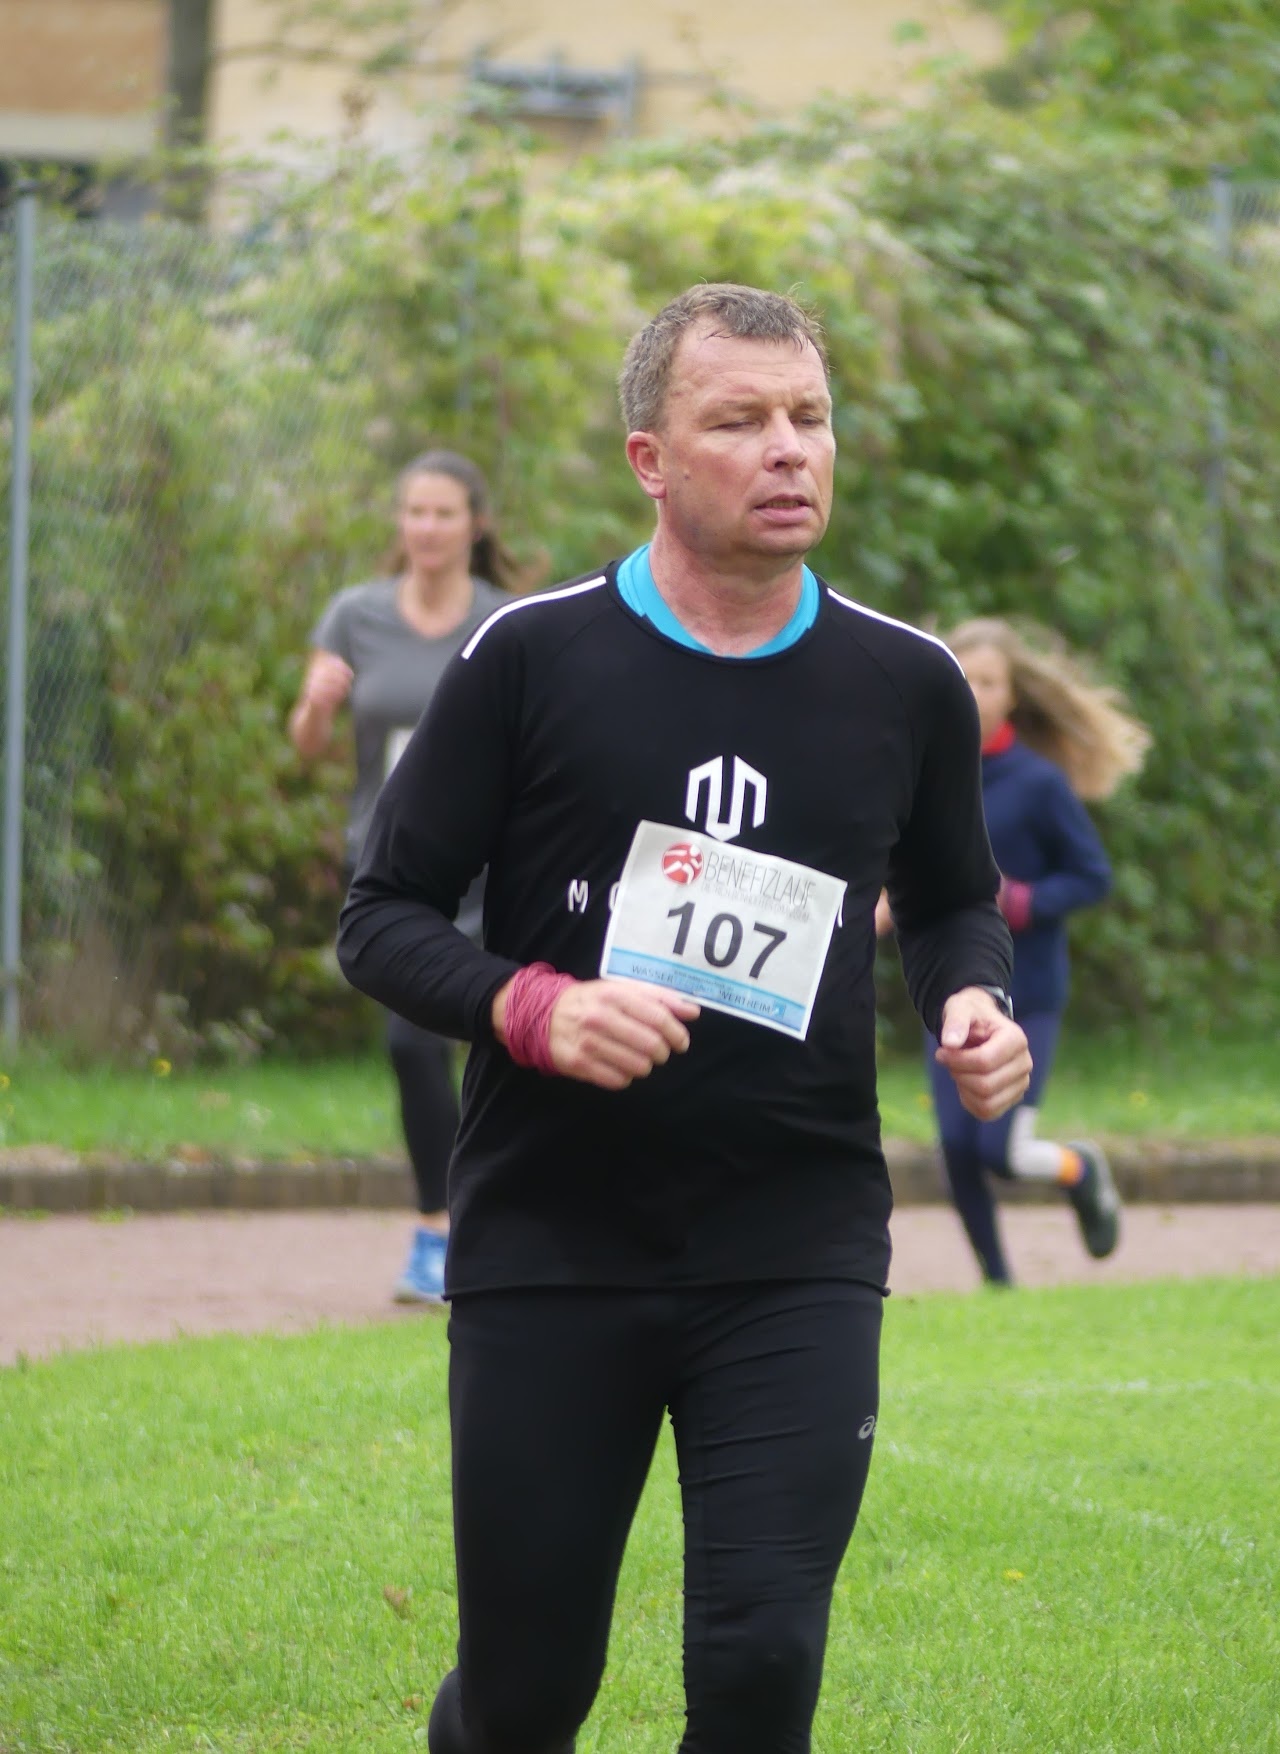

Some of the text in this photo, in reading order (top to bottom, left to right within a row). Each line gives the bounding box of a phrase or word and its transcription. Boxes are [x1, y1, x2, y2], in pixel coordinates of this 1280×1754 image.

[704, 851, 816, 909] BENEFIZLAUF
[667, 901, 788, 980] 107
[719, 989, 771, 1014] WERTHEIM
